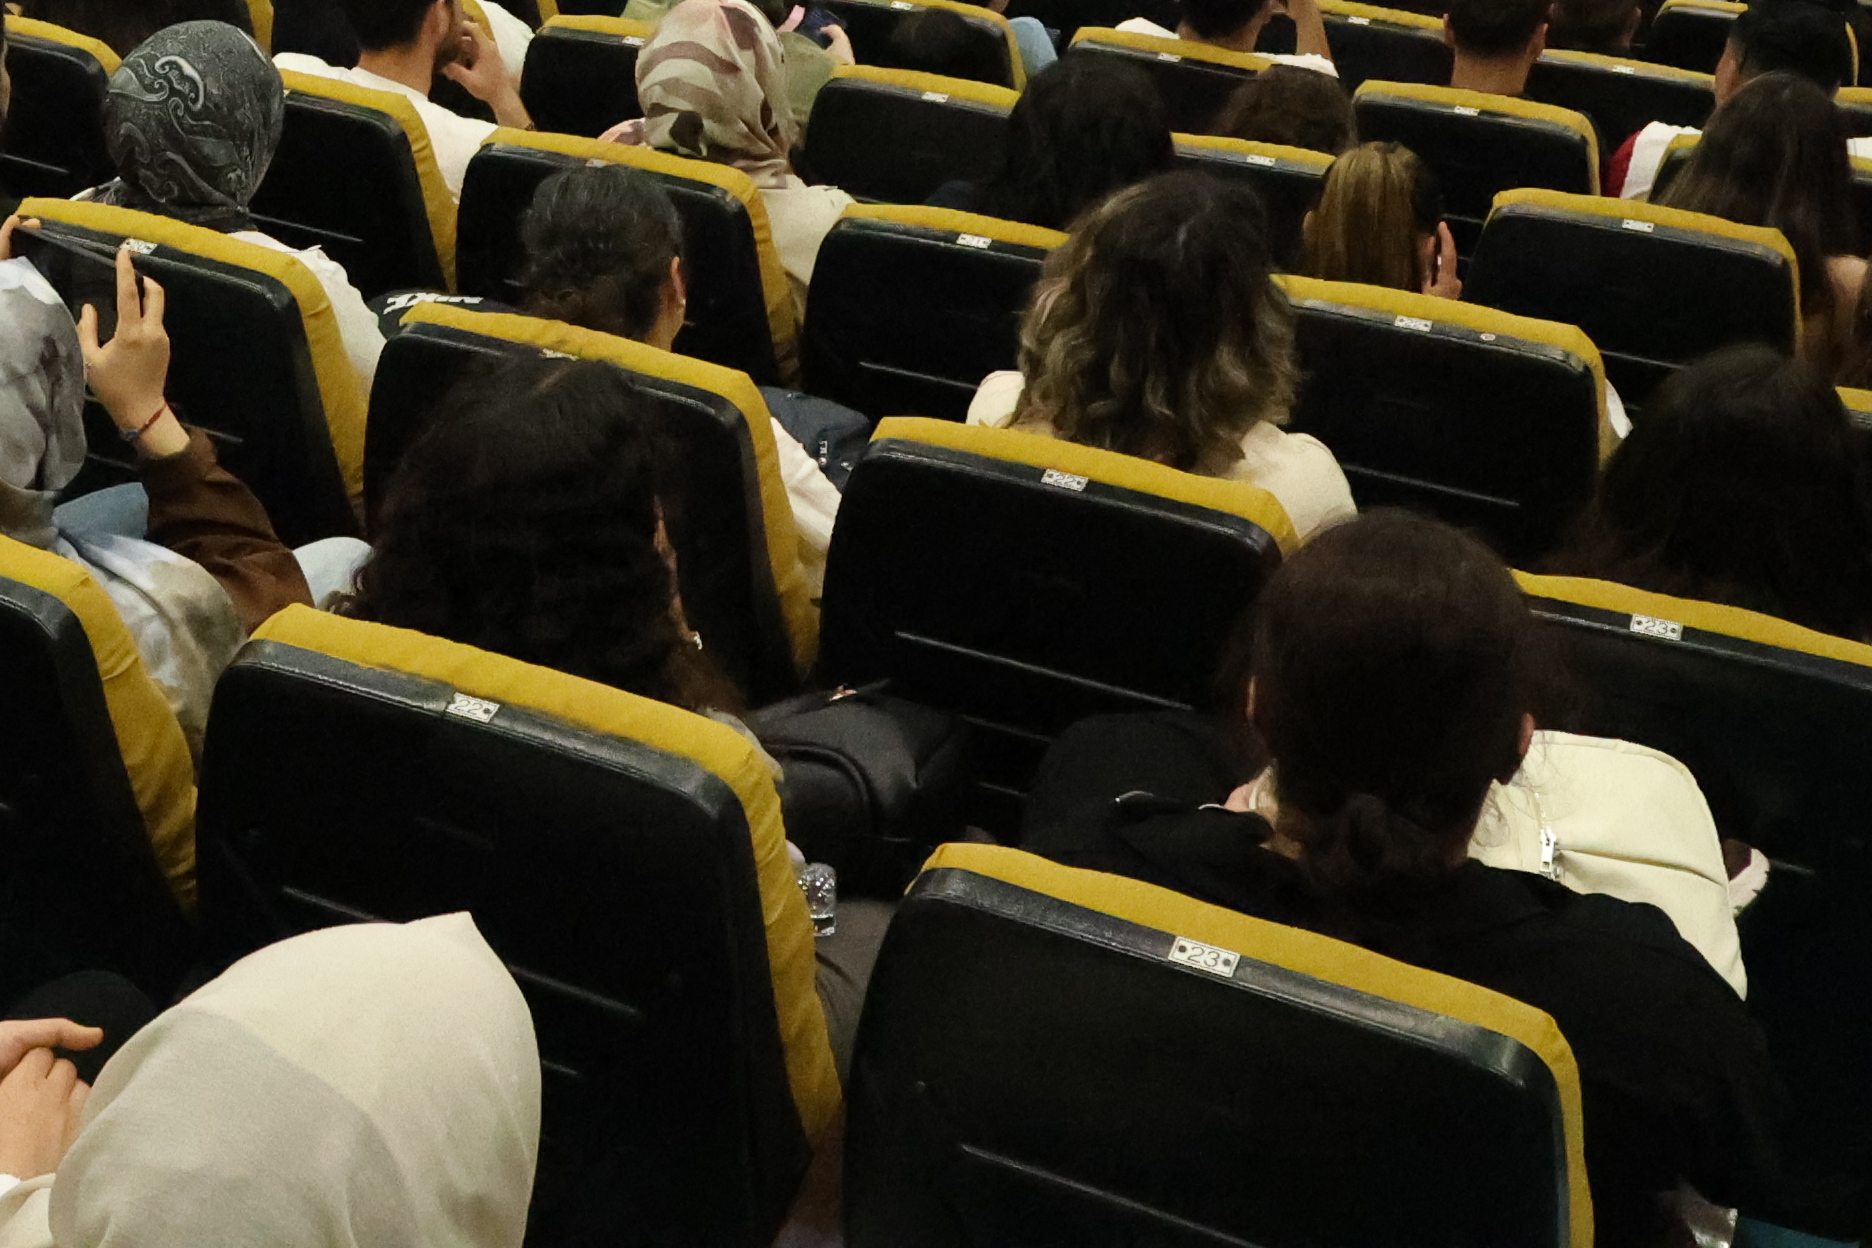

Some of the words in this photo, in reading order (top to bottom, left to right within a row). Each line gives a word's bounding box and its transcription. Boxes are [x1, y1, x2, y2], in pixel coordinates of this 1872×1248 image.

[1053, 472, 1078, 489] 22
[1644, 620, 1669, 636] 23
[454, 699, 484, 716] 22
[1187, 946, 1221, 968] 23
